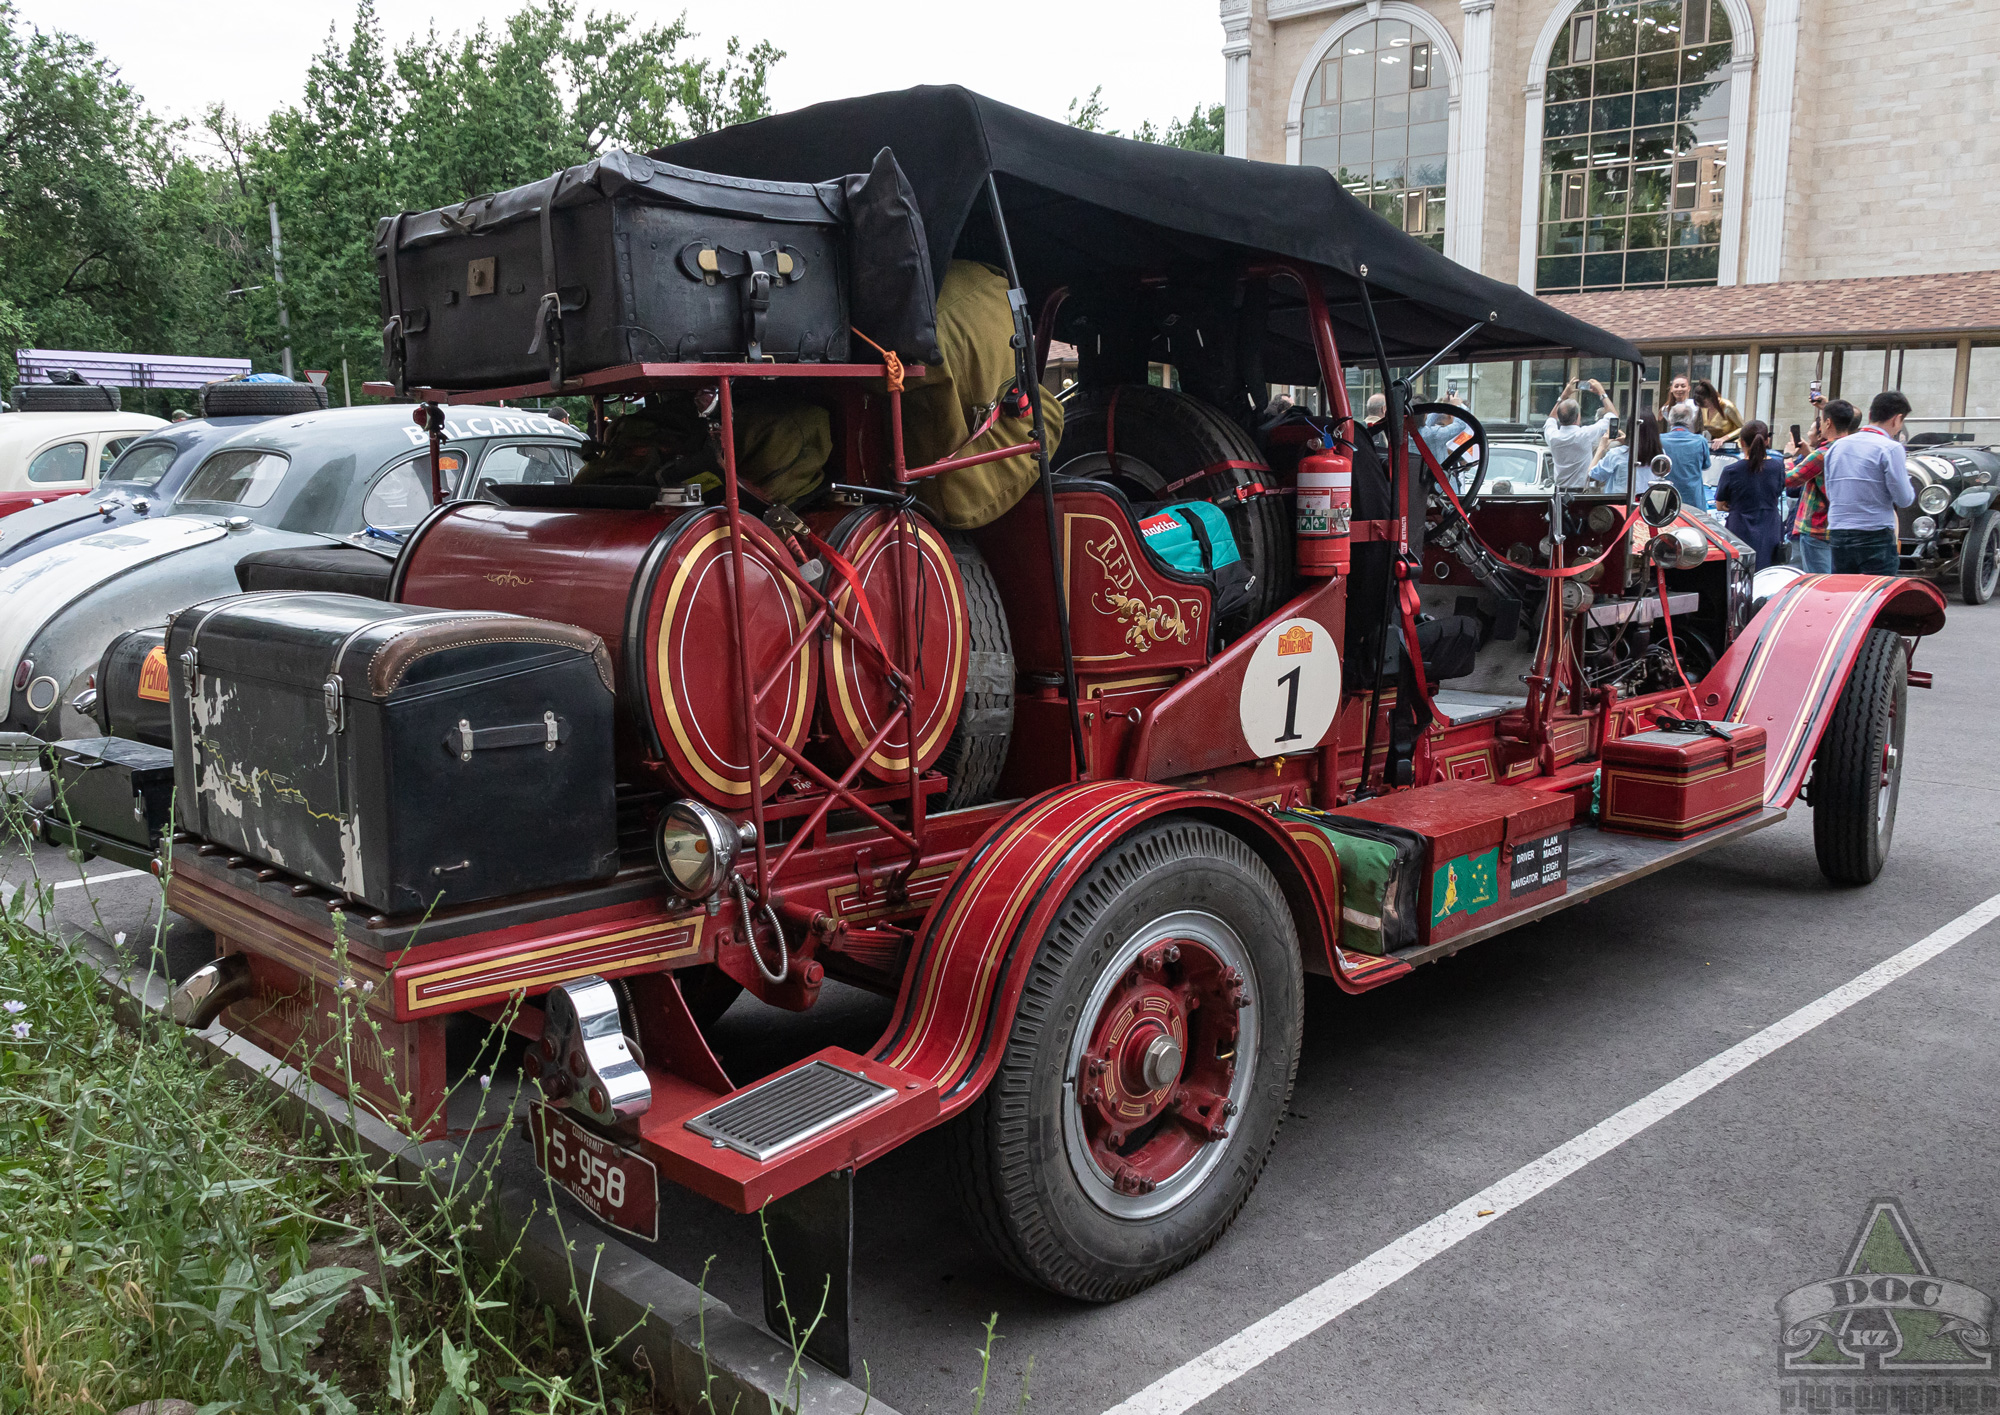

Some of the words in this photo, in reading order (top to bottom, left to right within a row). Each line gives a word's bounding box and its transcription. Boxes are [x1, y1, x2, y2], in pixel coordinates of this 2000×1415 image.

[1274, 665, 1303, 744] 1
[1543, 835, 1558, 848] ALAN
[1516, 849, 1535, 864] DRIVER
[1543, 845, 1562, 858] MADEN
[1542, 860, 1559, 873] LEIGH
[1511, 872, 1539, 890] NAVIGATOR
[1542, 871, 1561, 884] MADEN
[571, 1125, 584, 1144] CLUB
[583, 1132, 604, 1155] PERMIT
[570, 1180, 602, 1214] VICTORIA
